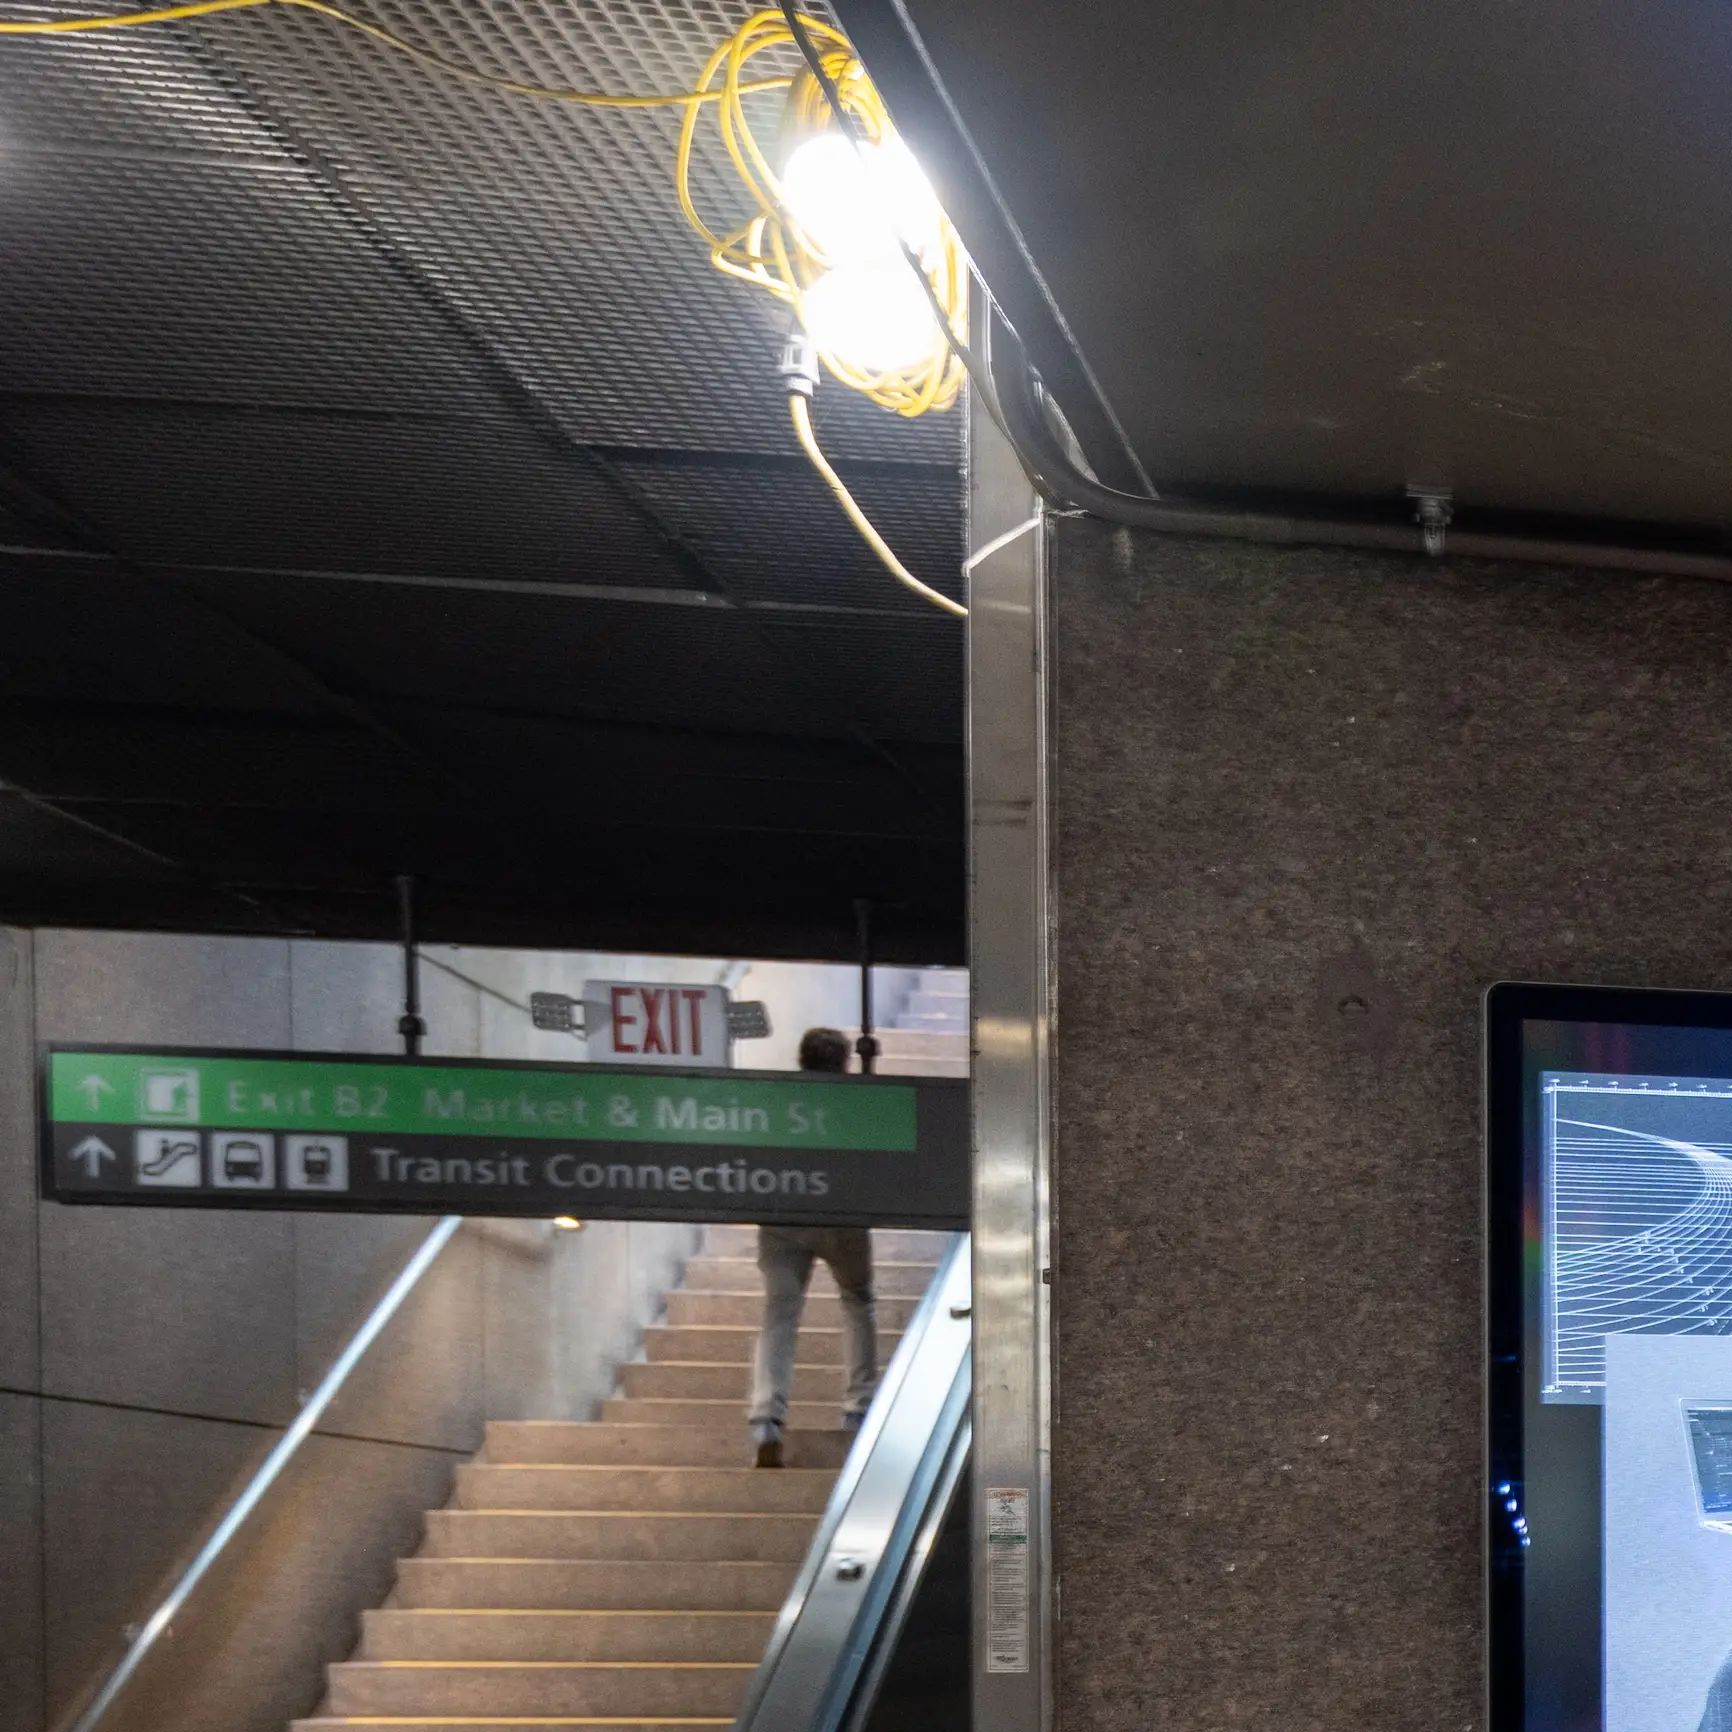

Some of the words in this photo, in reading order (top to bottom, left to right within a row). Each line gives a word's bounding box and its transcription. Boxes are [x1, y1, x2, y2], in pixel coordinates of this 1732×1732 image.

[611, 986, 709, 1056] EXIT
[228, 1080, 315, 1117] Exit
[335, 1083, 389, 1119] B2
[422, 1086, 588, 1125] Market
[606, 1094, 639, 1129] &
[655, 1095, 770, 1132] Main
[788, 1099, 828, 1136] St
[370, 1148, 530, 1186] Transit
[545, 1153, 830, 1197] Connections
